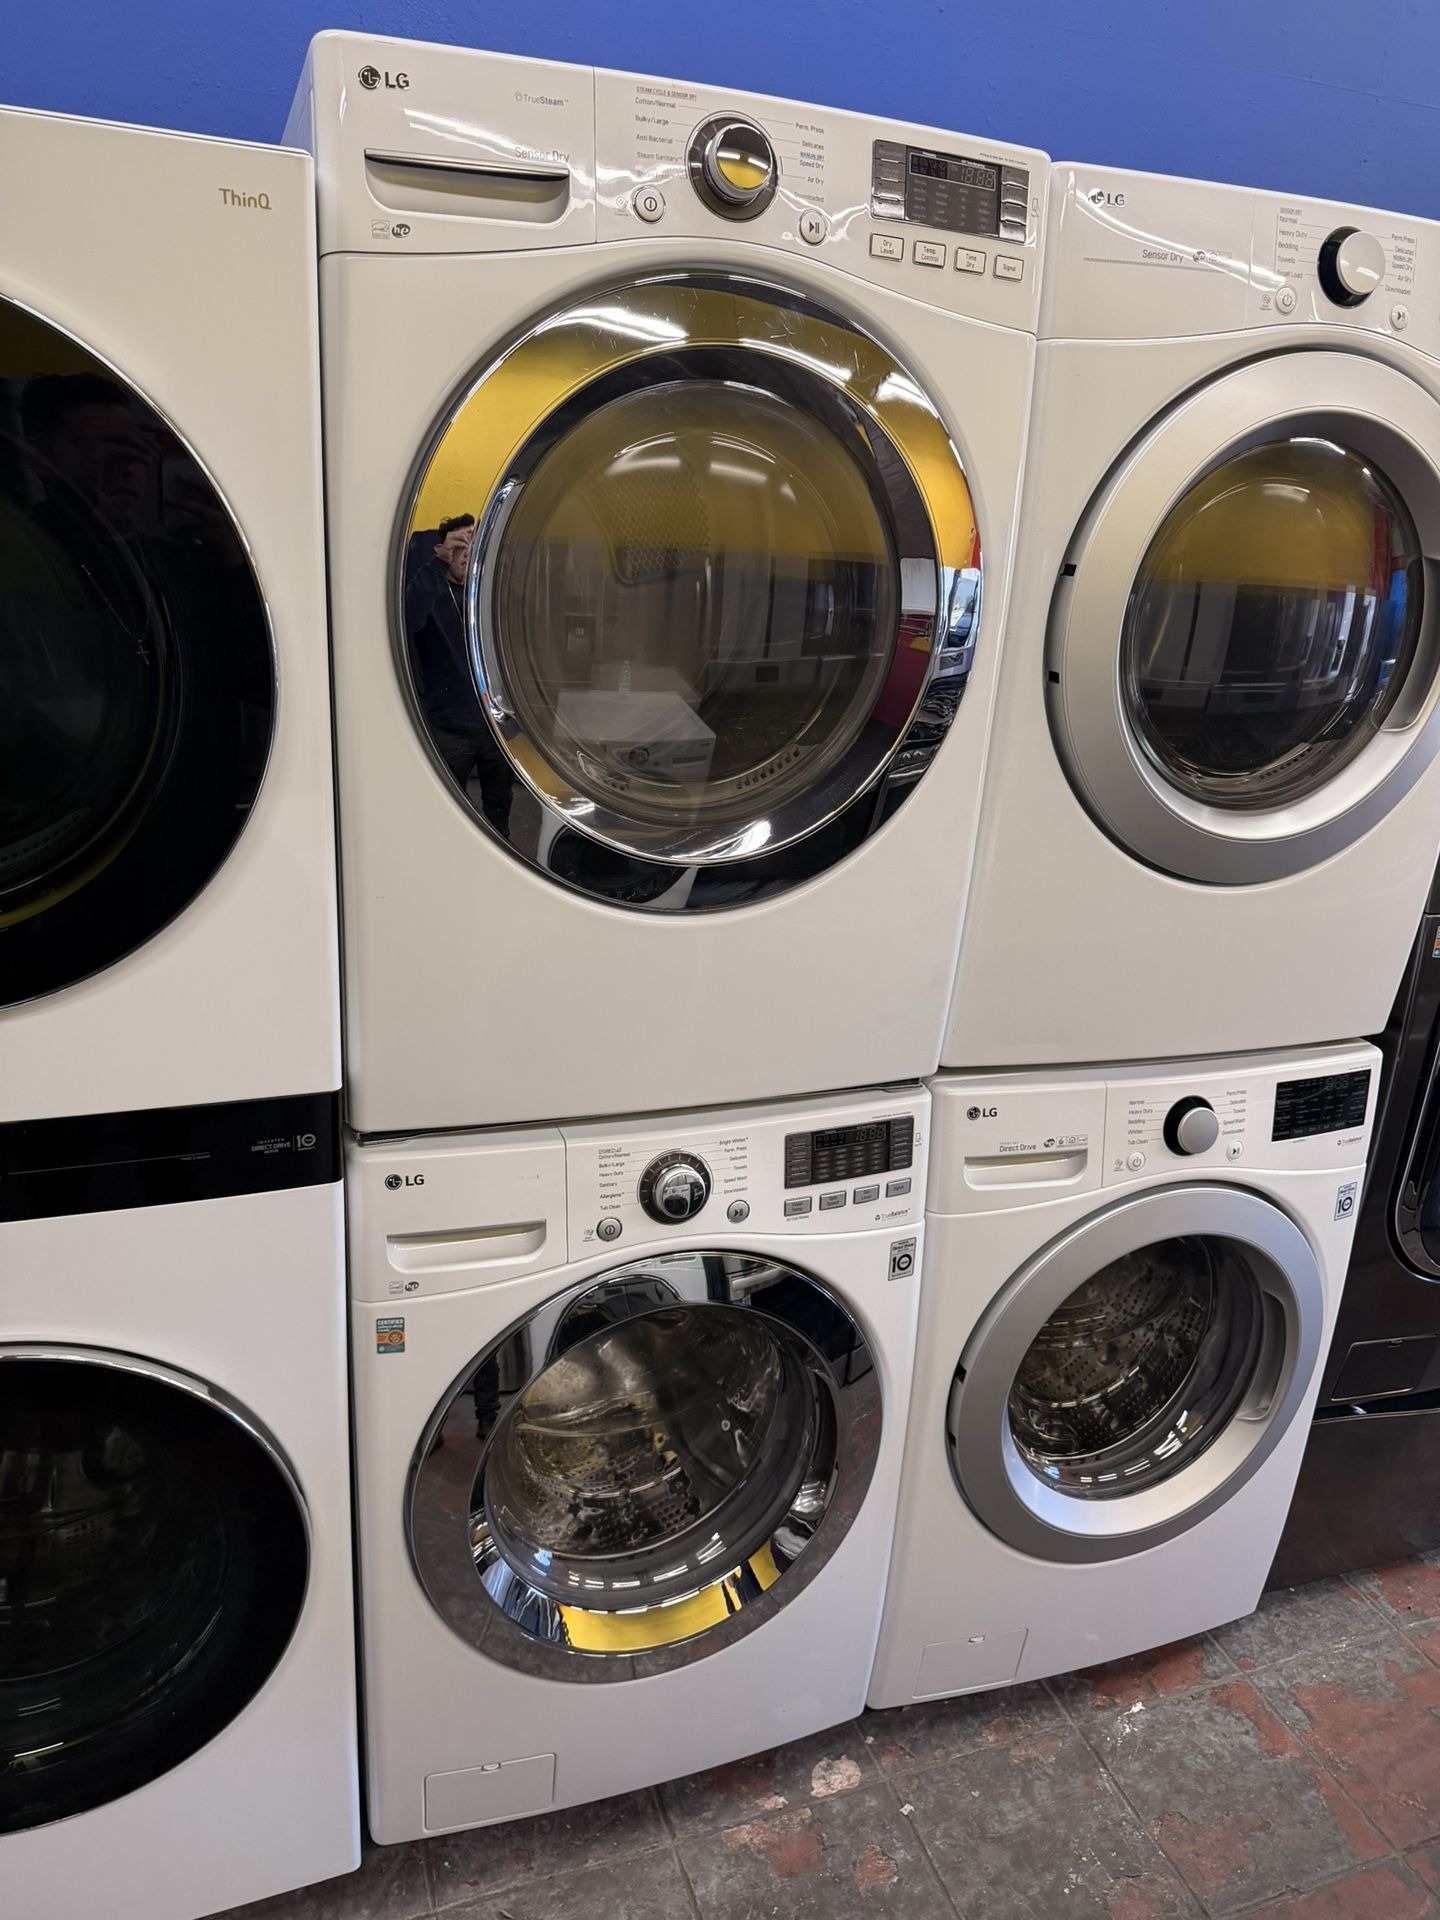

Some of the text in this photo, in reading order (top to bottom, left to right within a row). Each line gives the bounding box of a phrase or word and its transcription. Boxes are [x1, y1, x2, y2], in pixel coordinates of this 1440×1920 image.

[385, 72, 410, 90] LG
[635, 97, 676, 108] Cotton/Normal
[635, 114, 670, 126] Bulky/Large
[796, 122, 824, 134] Perm. Press
[636, 134, 673, 144] Anti Bacterial
[802, 140, 824, 150] Delicates
[514, 146, 570, 164] Sensor Dry
[637, 151, 654, 160] Steam
[800, 160, 824, 171] Speed Dry
[816, 178, 824, 186] Dry
[218, 188, 272, 210] ThinQ
[1107, 193, 1125, 206] LG
[1280, 216, 1298, 224] Normal
[1279, 230, 1308, 240] Heavy Duty
[1404, 236, 1416, 244] Press
[882, 239, 892, 250] Dry
[1278, 241, 1299, 252] Bedding
[880, 246, 894, 256] Level
[924, 246, 936, 256] Temp
[1394, 246, 1414, 256] Delicates
[921, 252, 939, 262] Control
[966, 253, 976, 262] Time
[1142, 249, 1184, 264] Sensor Dry
[1278, 255, 1296, 264] Towels
[966, 260, 975, 270] Dry
[1002, 264, 1016, 274] Signal
[1392, 262, 1414, 272] Speed Dry
[1290, 271, 1304, 279] Load
[1404, 276, 1412, 284] Dry
[1385, 284, 1412, 296] Downloaded
[982, 1107, 998, 1118] LG
[251, 1144, 272, 1152] DIRECT
[273, 1141, 292, 1149] DRIVE
[1000, 1144, 1019, 1152] Direct
[599, 1152, 630, 1160] Cotton/Normal
[730, 1154, 748, 1162] Delicates
[405, 1174, 425, 1187] LG
[1338, 1196, 1352, 1214] 10
[892, 1254, 912, 1273] 10
